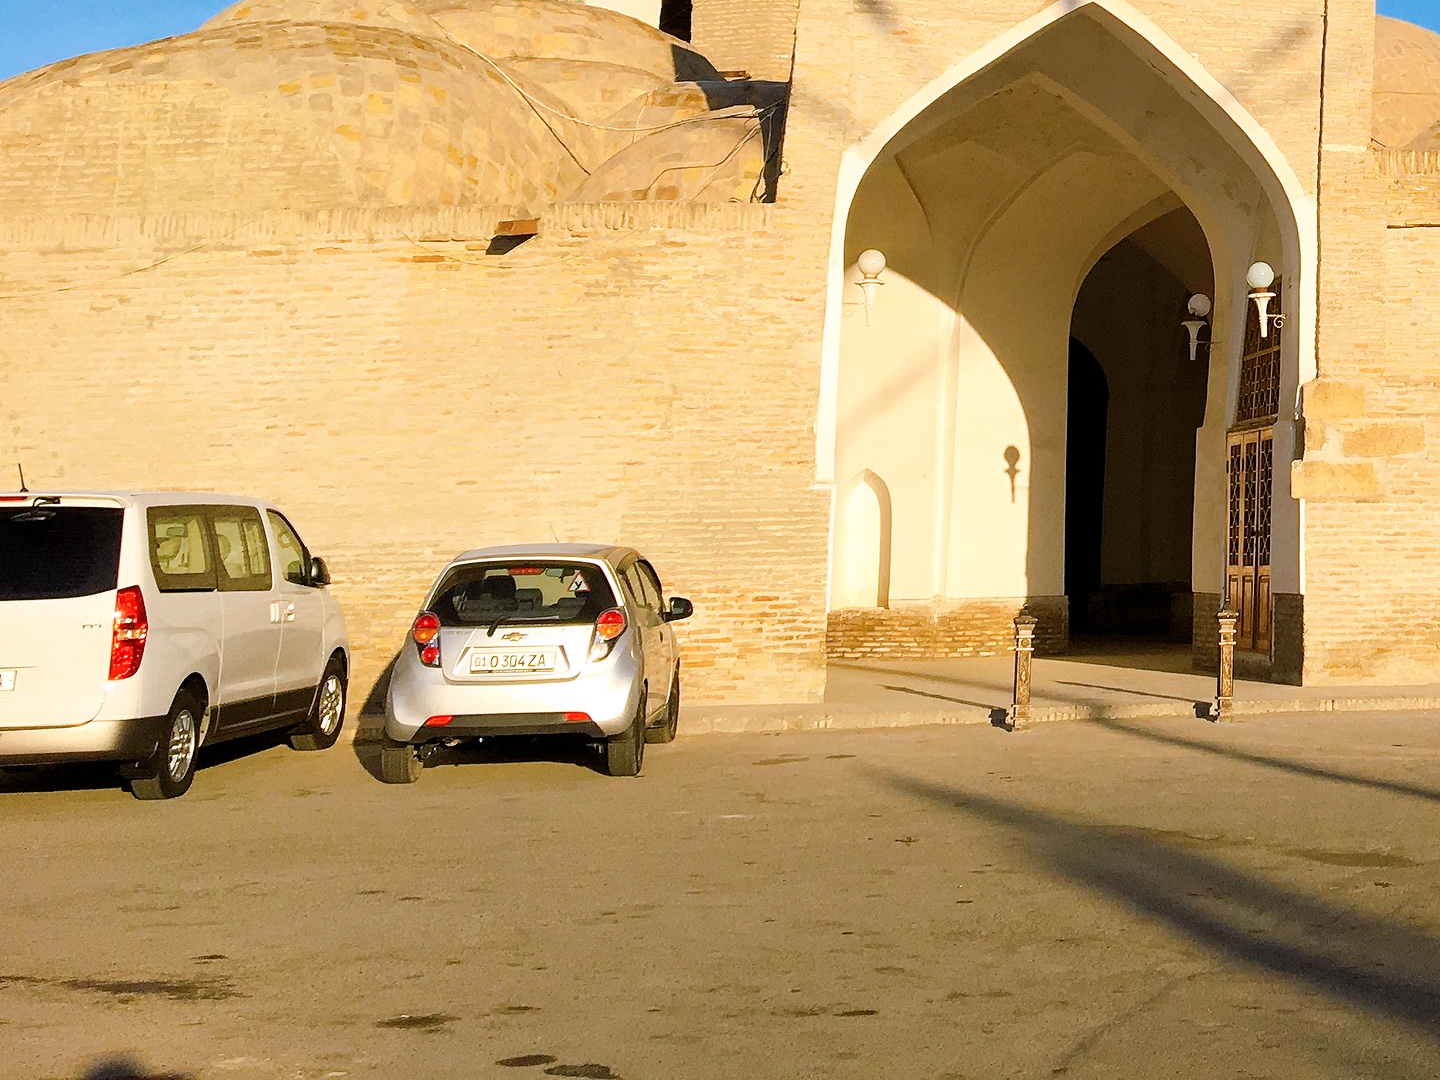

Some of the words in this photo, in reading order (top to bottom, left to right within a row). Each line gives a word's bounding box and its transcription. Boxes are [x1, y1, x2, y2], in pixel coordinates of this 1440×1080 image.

[474, 657, 486, 667] 01
[501, 655, 525, 667] 304
[528, 654, 546, 667] ZA
